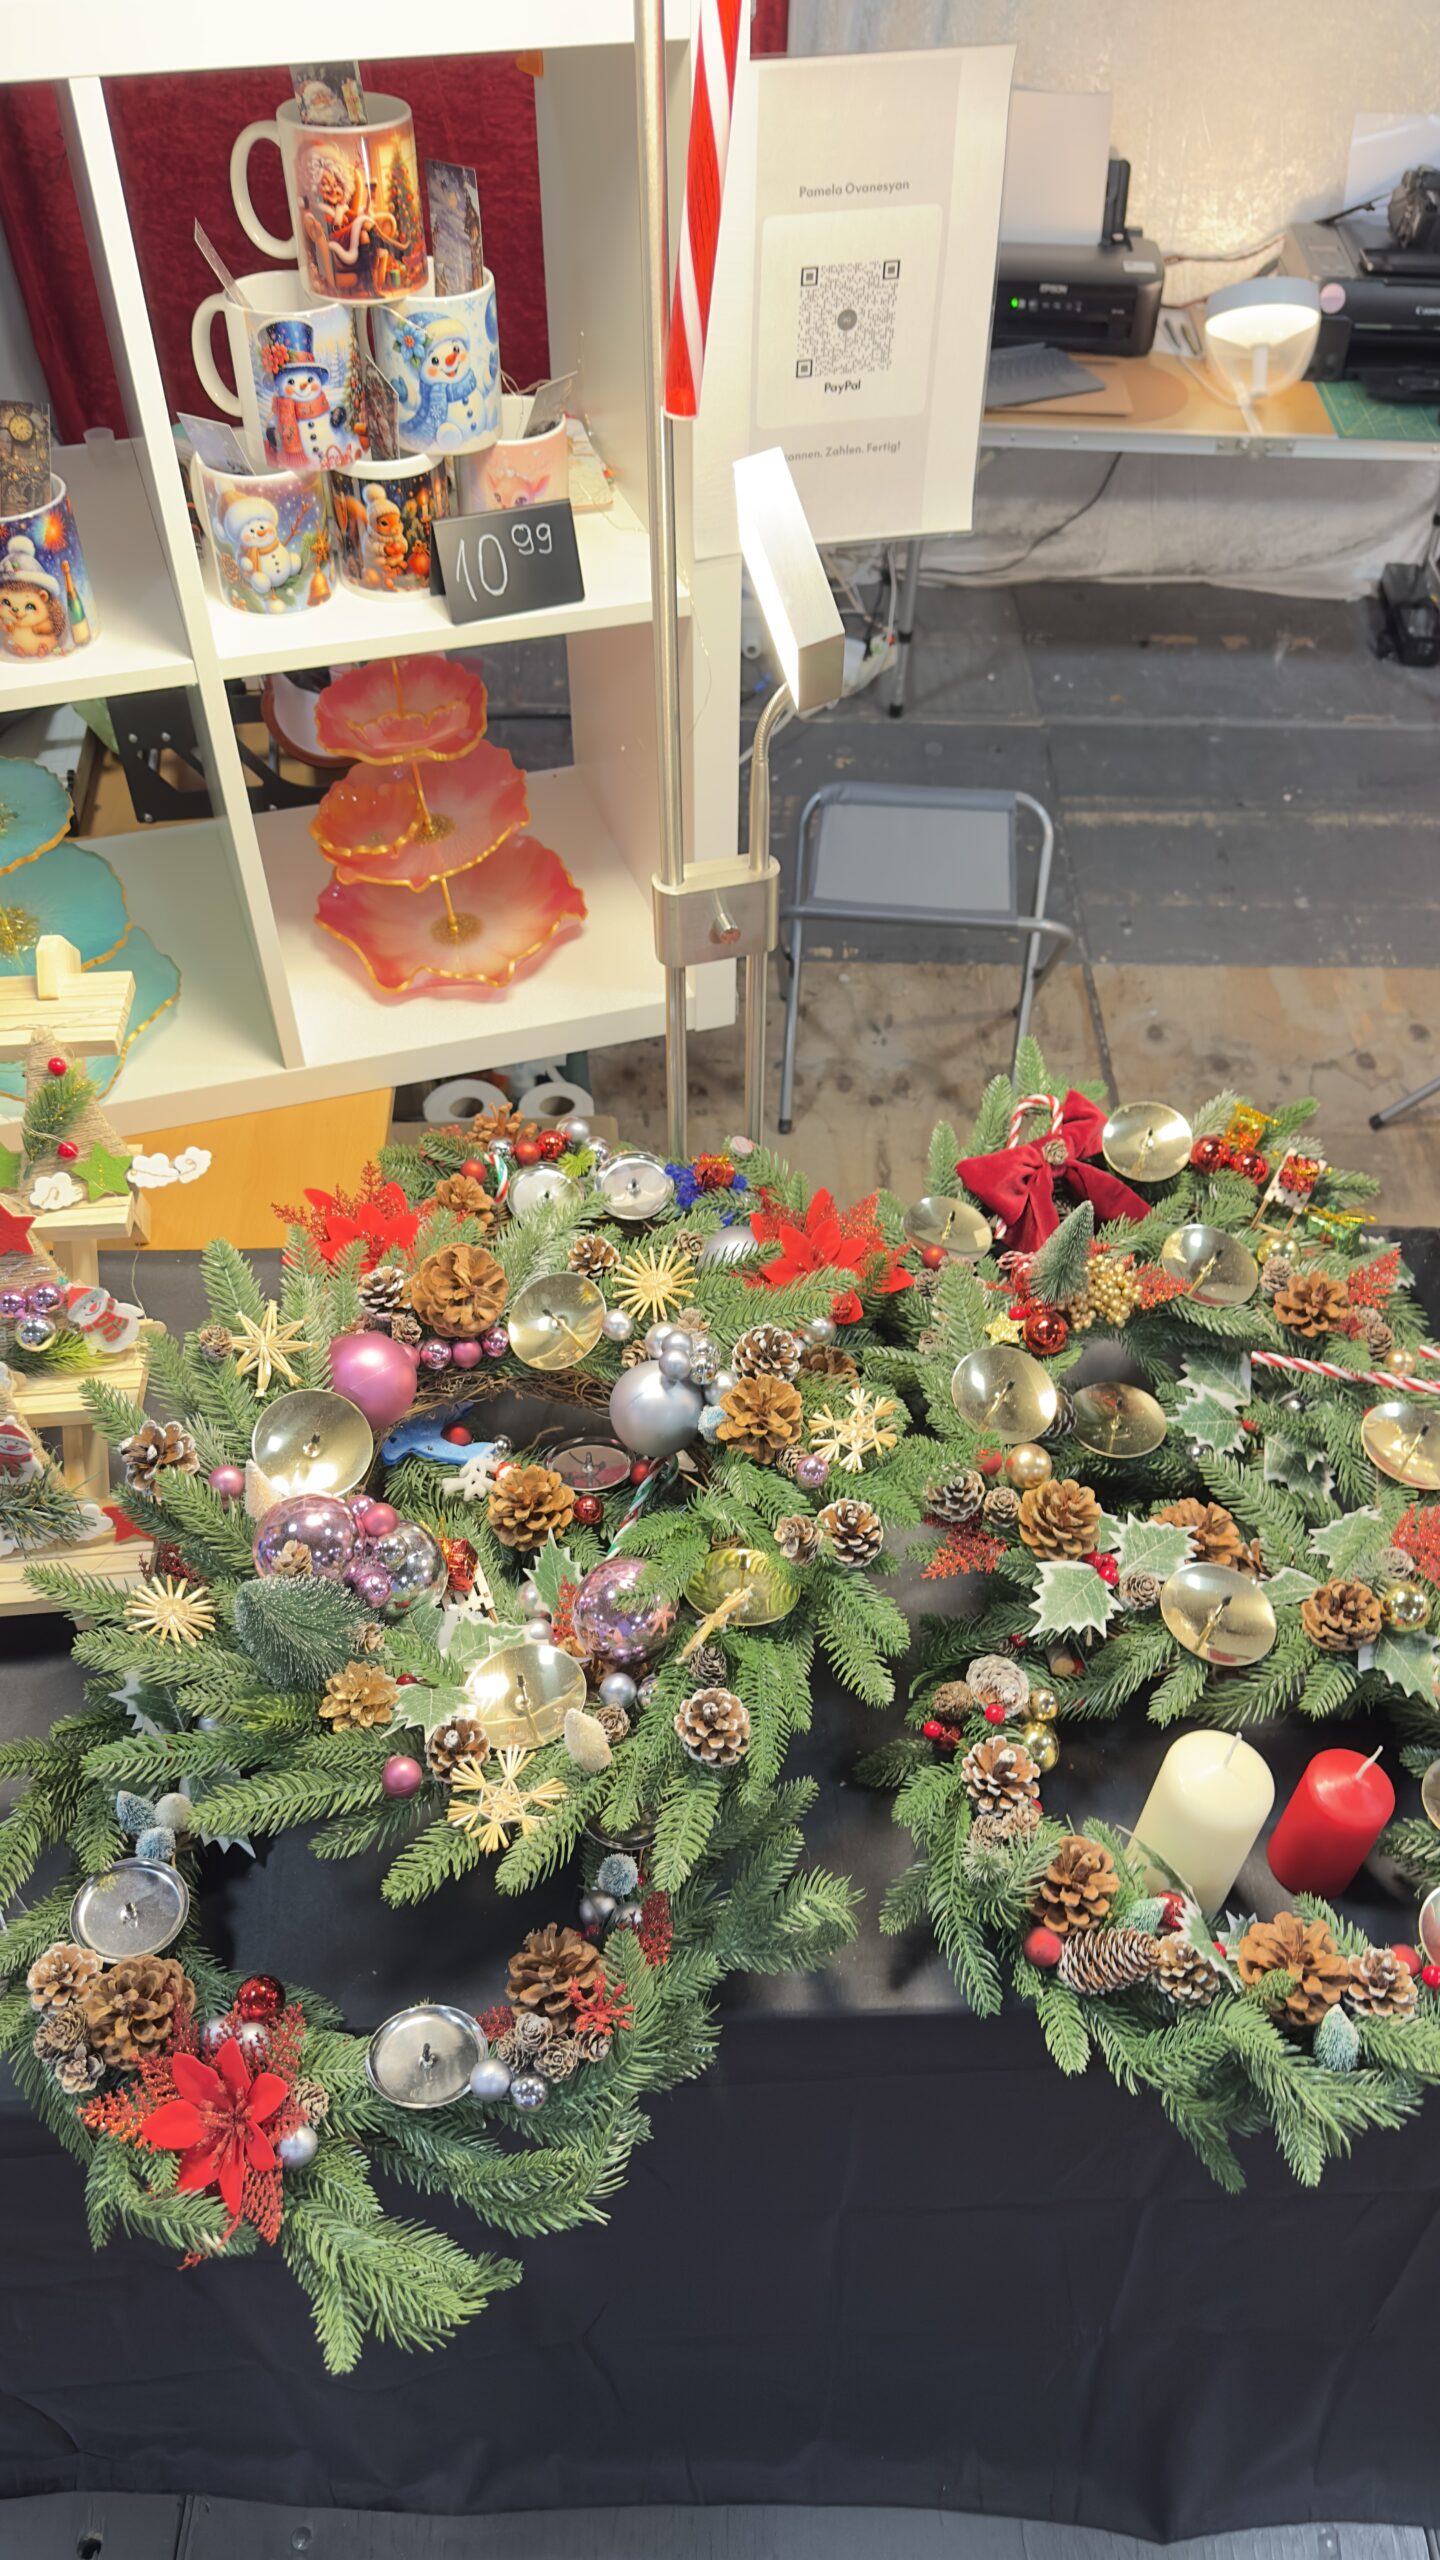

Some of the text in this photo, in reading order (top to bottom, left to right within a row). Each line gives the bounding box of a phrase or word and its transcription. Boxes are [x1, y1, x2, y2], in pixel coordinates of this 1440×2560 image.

[799, 180, 910, 198] Pamela Ovanesyan
[824, 379, 861, 395] PayPal
[784, 440, 901, 462] annen. Zahlen. Fertig!
